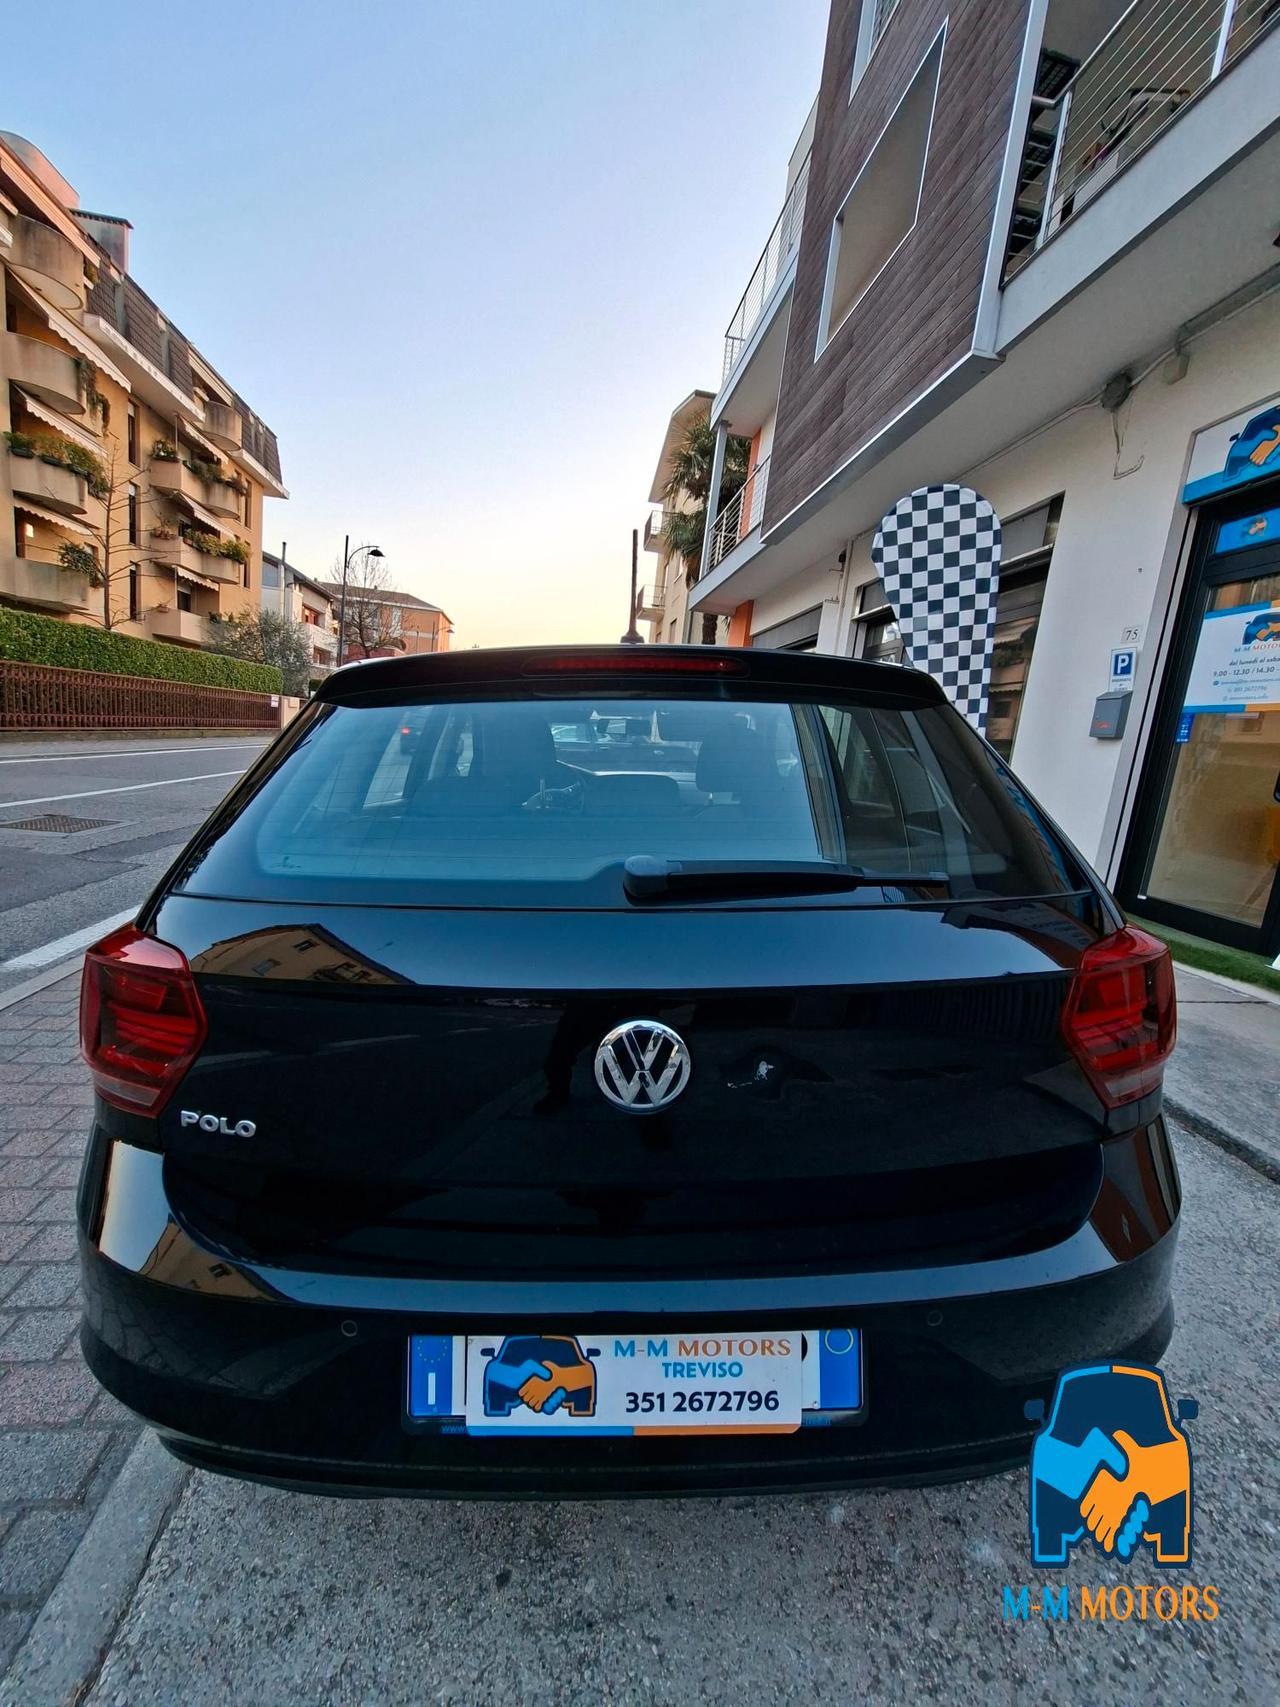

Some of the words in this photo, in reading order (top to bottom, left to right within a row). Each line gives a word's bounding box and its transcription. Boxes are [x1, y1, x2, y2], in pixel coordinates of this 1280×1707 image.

[1125, 629, 1139, 641] 75
[1252, 643, 1280, 651] MOTO
[1116, 655, 1130, 674] P
[181, 1110, 256, 1138] POLO
[614, 1339, 668, 1357] M-M
[678, 1338, 792, 1357] MOTORS
[662, 1361, 744, 1378] TREVISO
[625, 1391, 666, 1413] 351
[672, 1390, 780, 1413] 2672796
